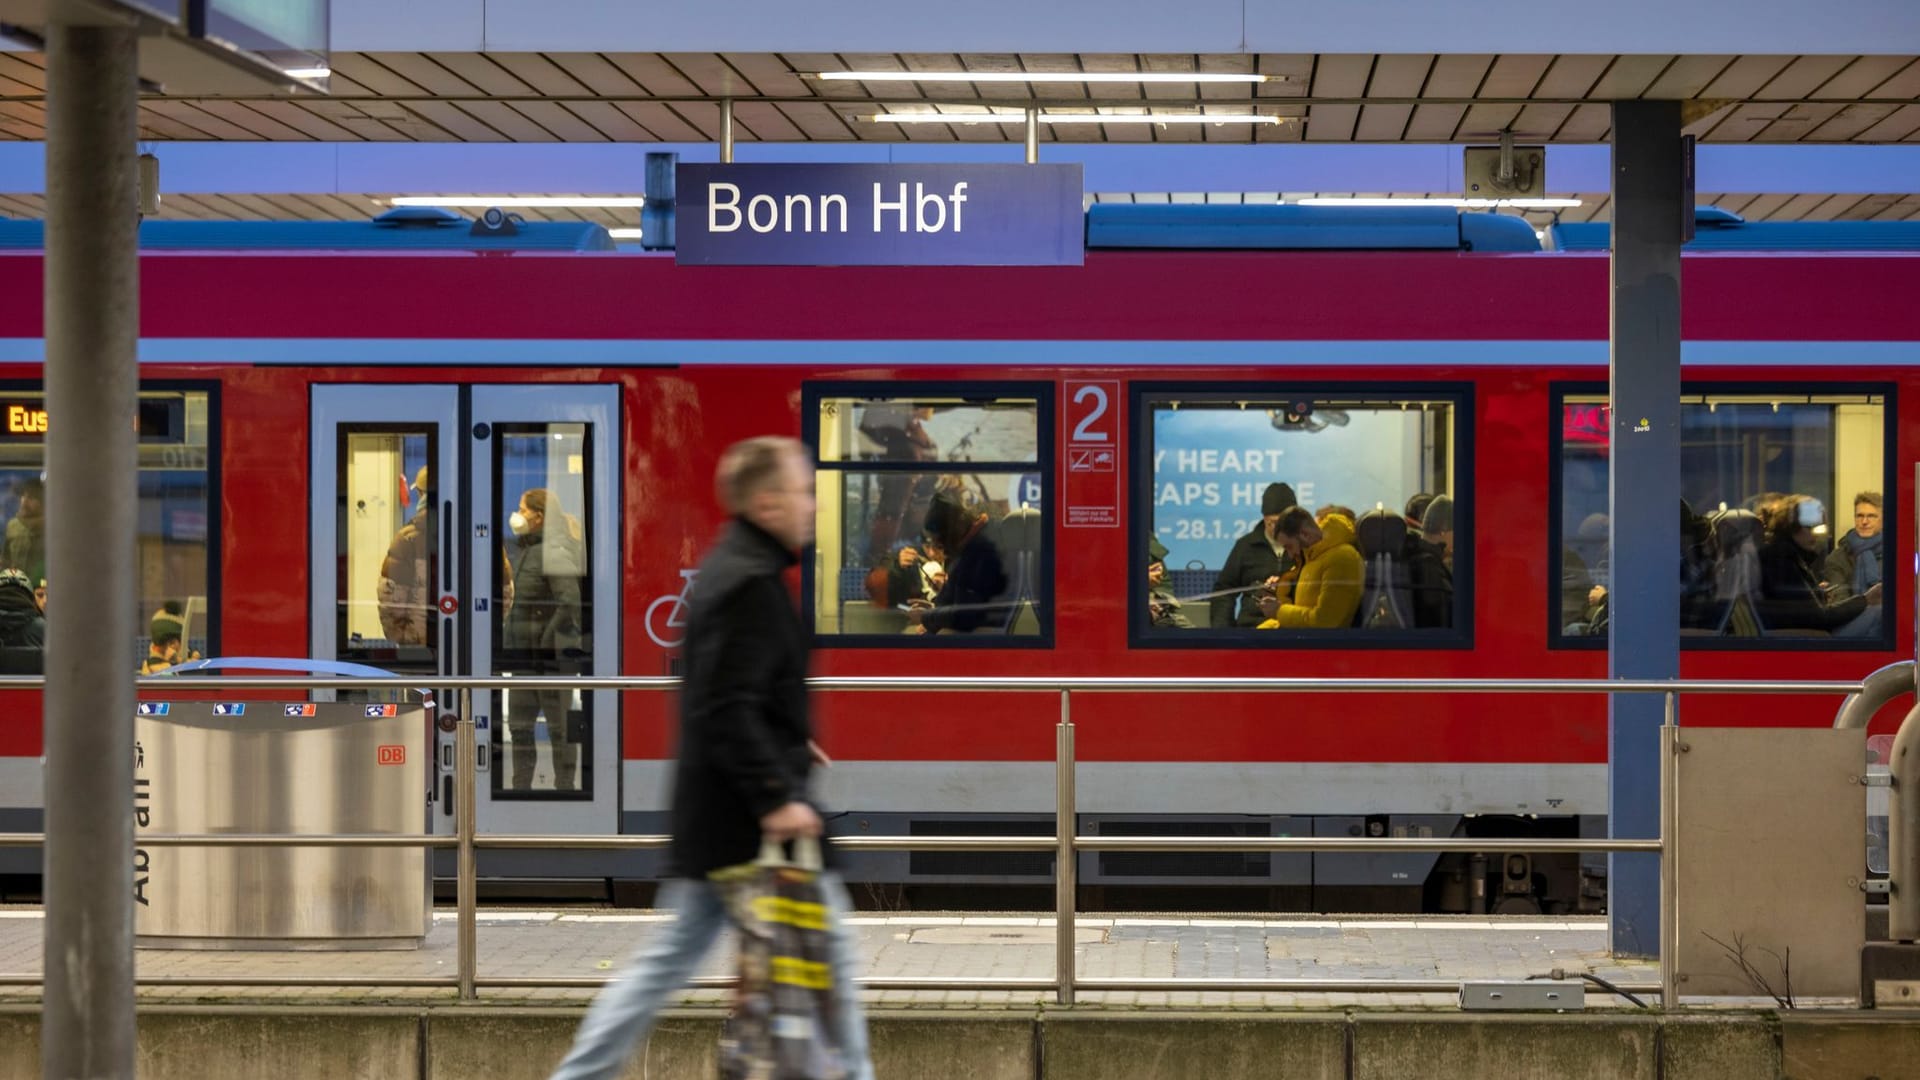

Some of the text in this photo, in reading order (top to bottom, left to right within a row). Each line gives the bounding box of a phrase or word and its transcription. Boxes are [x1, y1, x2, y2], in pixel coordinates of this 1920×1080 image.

[708, 181, 968, 234] Bonn Hbf
[1072, 385, 1108, 441] 2
[1178, 449, 1284, 474] HEART
[1231, 482, 1315, 506] HEE
[380, 747, 404, 763] DB
[134, 778, 150, 907] Aball
